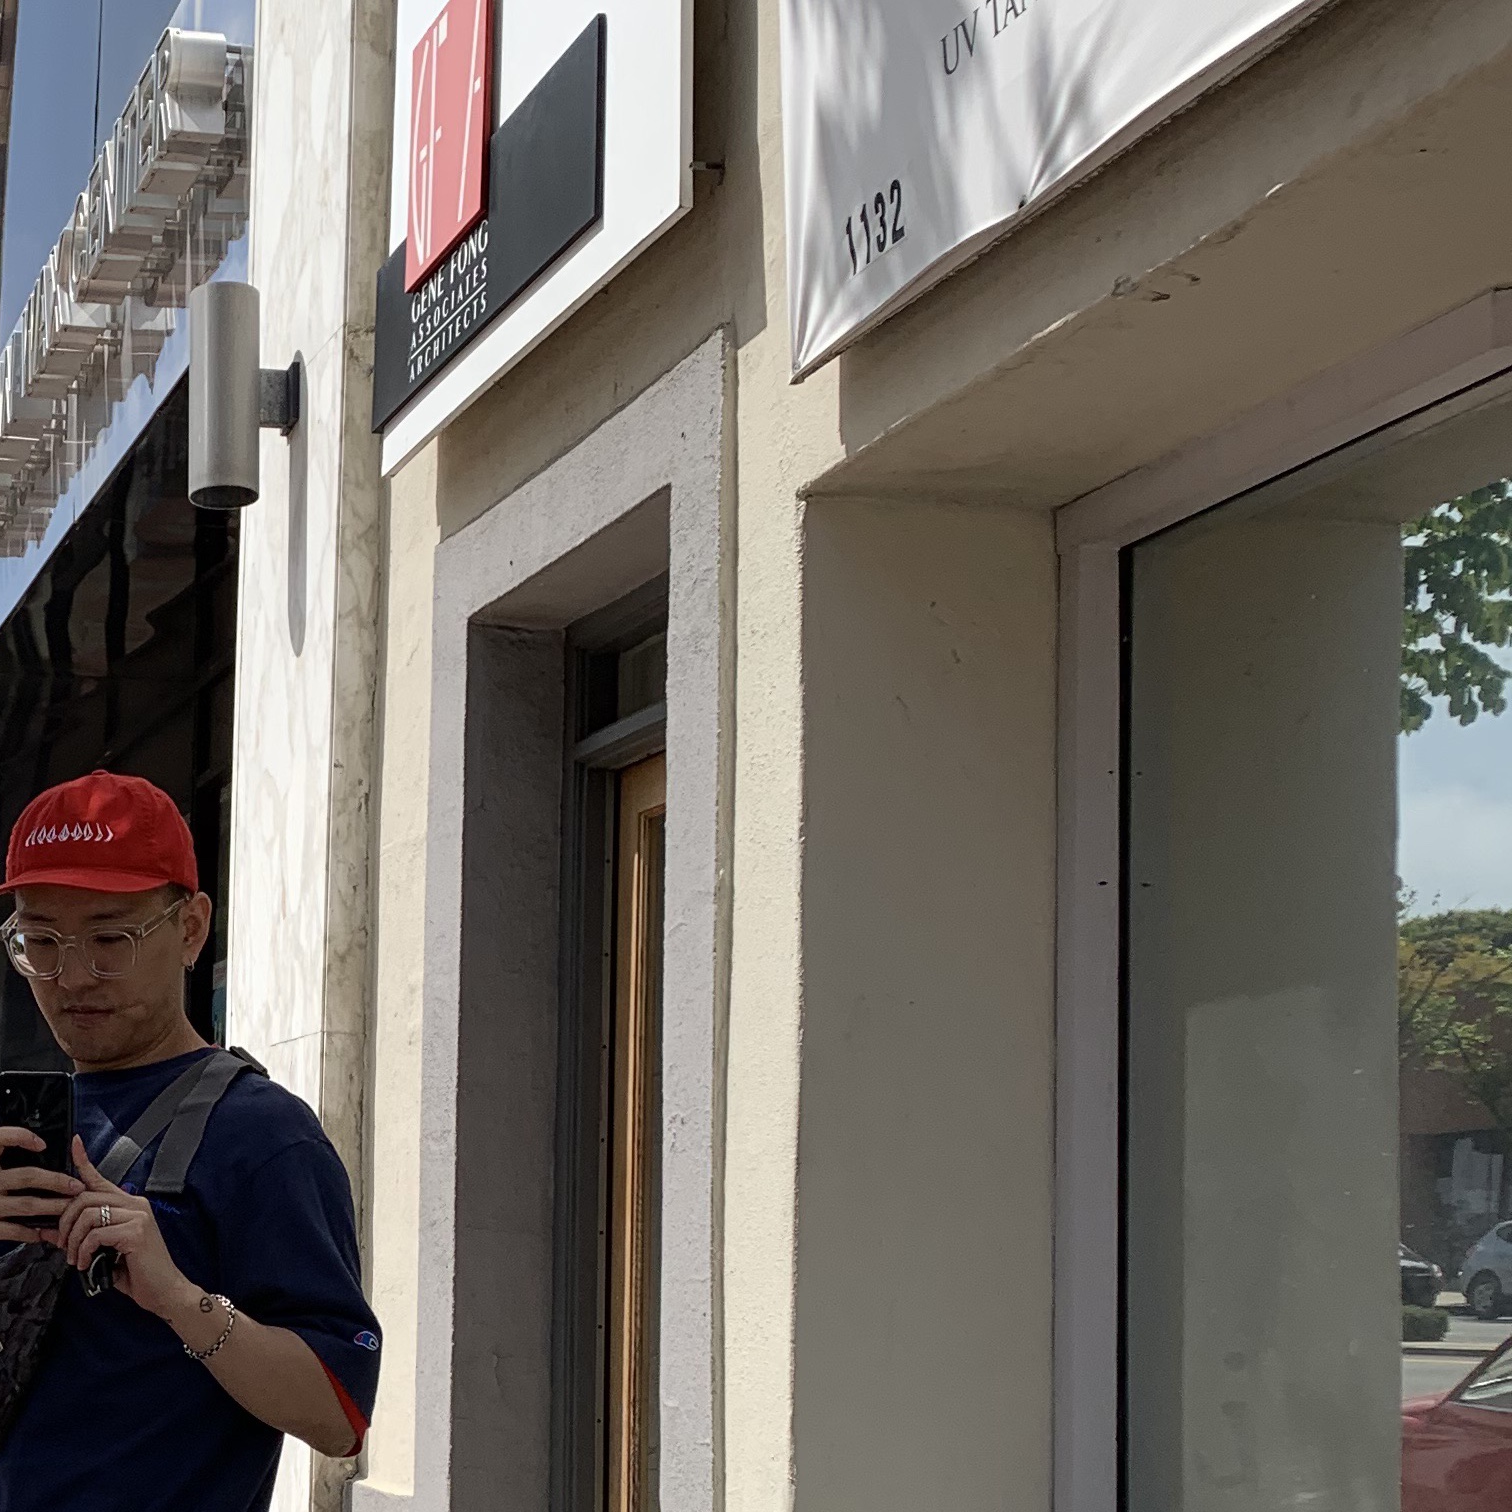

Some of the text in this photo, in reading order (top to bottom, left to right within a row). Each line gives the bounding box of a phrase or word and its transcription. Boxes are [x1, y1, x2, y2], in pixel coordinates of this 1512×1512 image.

[940, 0, 1027, 75] UV TA
[411, 219, 488, 323] GENE FONG
[845, 179, 905, 276] 1132
[409, 291, 487, 383] ARCHITECTS
[410, 257, 487, 351] ASSOCIATES
